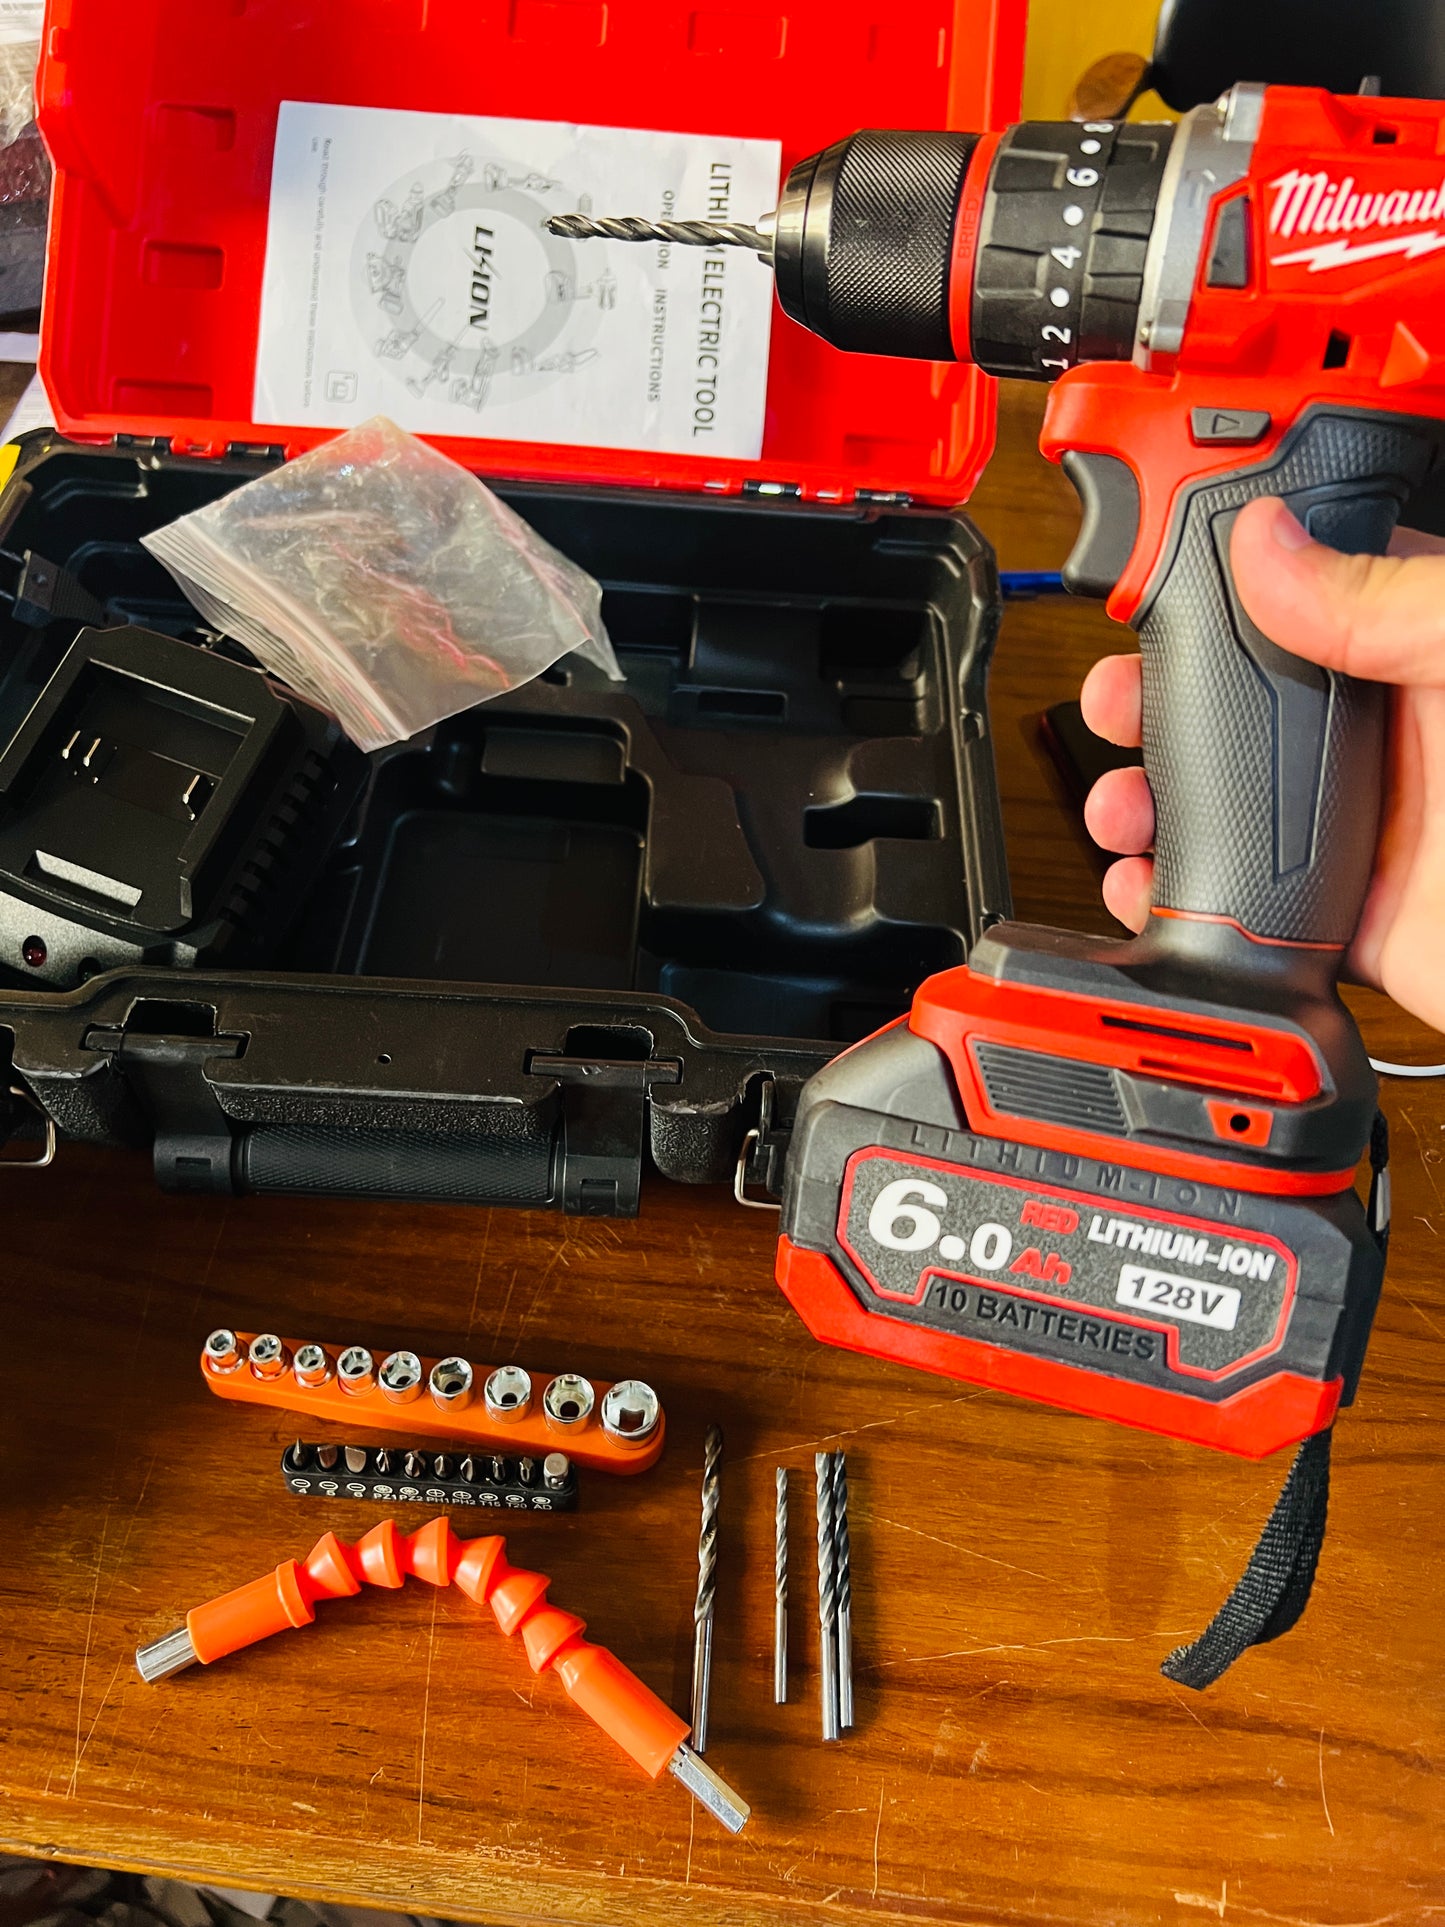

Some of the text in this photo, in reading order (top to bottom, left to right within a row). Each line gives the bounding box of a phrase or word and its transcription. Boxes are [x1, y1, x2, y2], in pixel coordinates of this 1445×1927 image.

[1041, 122, 1115, 371] 1 2 4 6 8
[648, 191, 674, 402] OPEION INSTRUCTIONS
[693, 162, 731, 437] LITHI ELECTRIC TOOL
[911, 1124, 1241, 1217] LITHIUM-ION
[868, 1178, 1072, 1286] 6.0 Ah
[1019, 1199, 1277, 1282] RED LITHIUM-ION
[933, 1284, 1156, 1361] 10 BATTERIES
[1130, 1274, 1226, 1317] 128V
[373, 1493, 397, 1501] PZ1
[400, 1494, 423, 1502] PZ2
[426, 1496, 450, 1504] PH1
[452, 1498, 476, 1506] PH2
